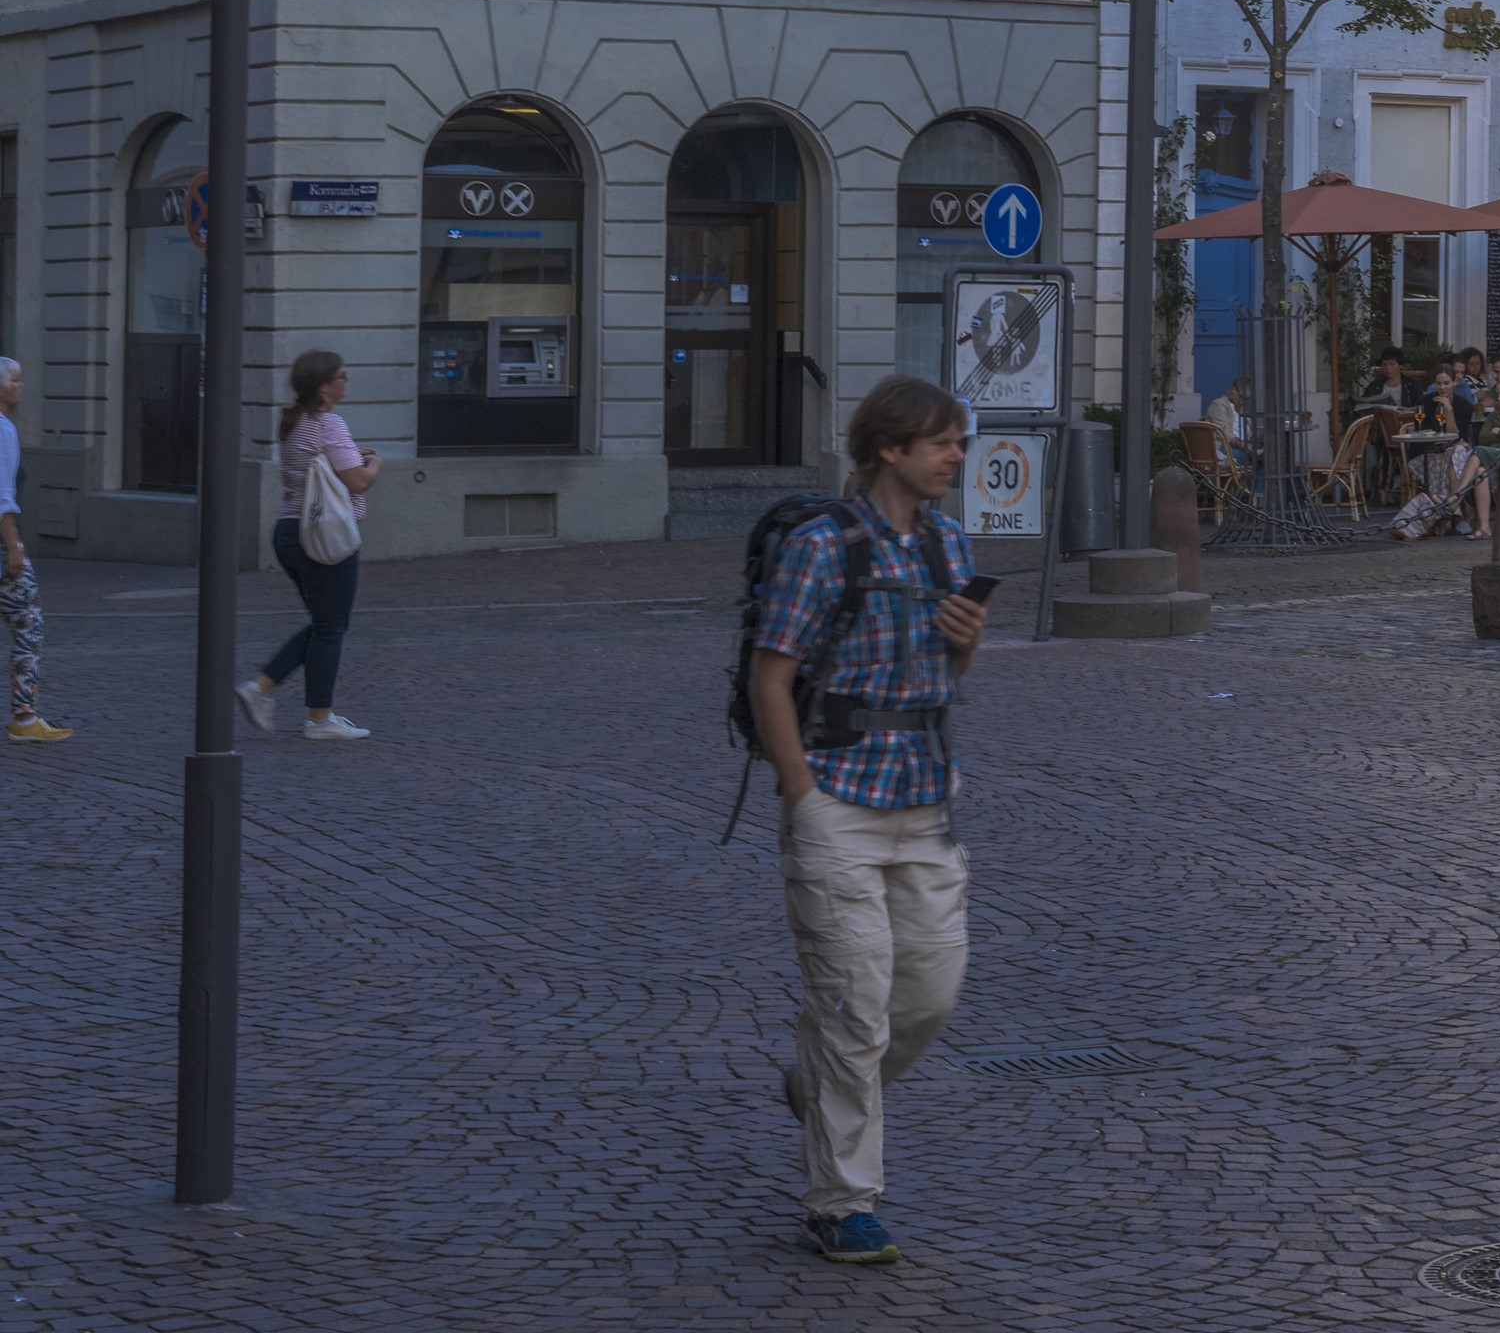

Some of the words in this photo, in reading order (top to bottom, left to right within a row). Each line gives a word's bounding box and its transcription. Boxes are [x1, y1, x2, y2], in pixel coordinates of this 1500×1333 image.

[1243, 38, 1252, 52] 9
[980, 381, 1032, 402] ZONE
[987, 459, 1019, 490] 30
[981, 511, 1023, 533] ZONE
